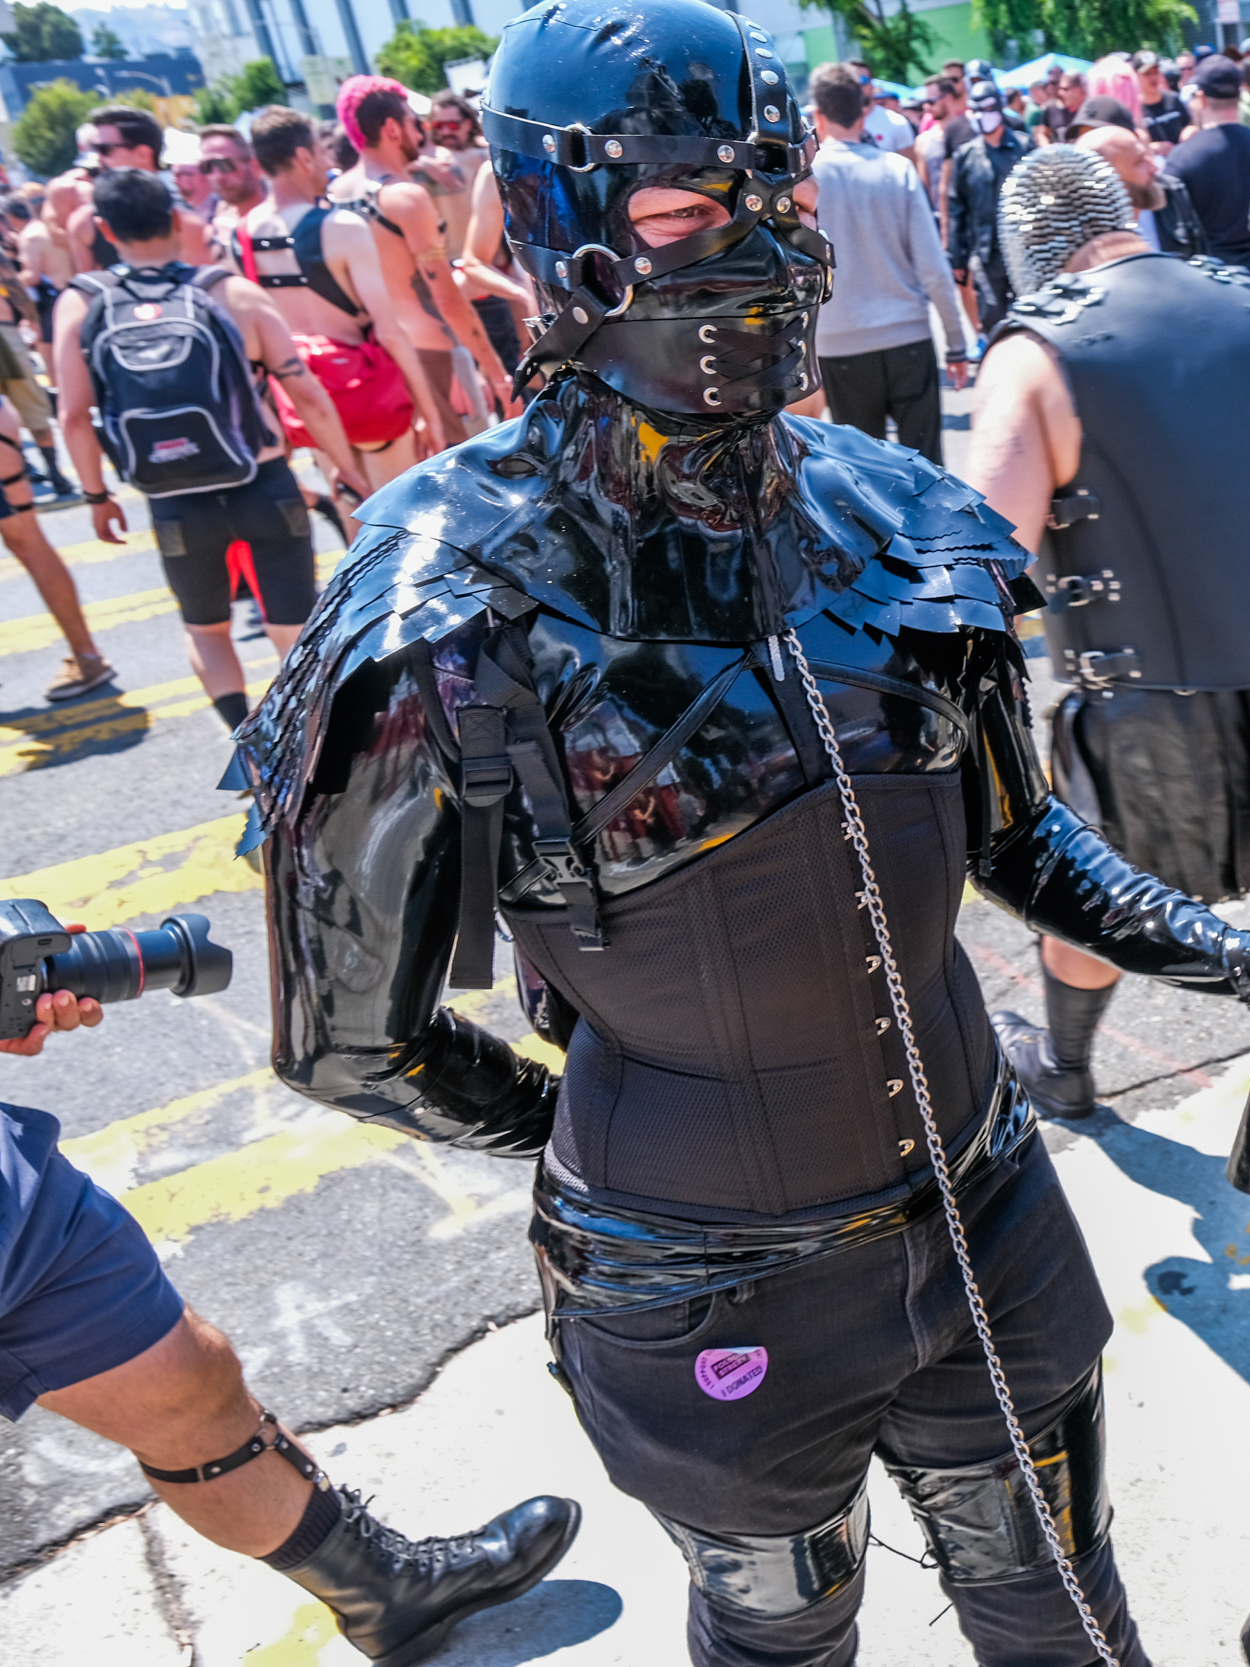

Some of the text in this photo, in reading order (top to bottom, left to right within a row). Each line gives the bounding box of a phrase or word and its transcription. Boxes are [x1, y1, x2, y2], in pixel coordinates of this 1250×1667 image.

[700, 1357, 711, 1386] SUPPORT
[721, 1366, 763, 1397] I DONATED
